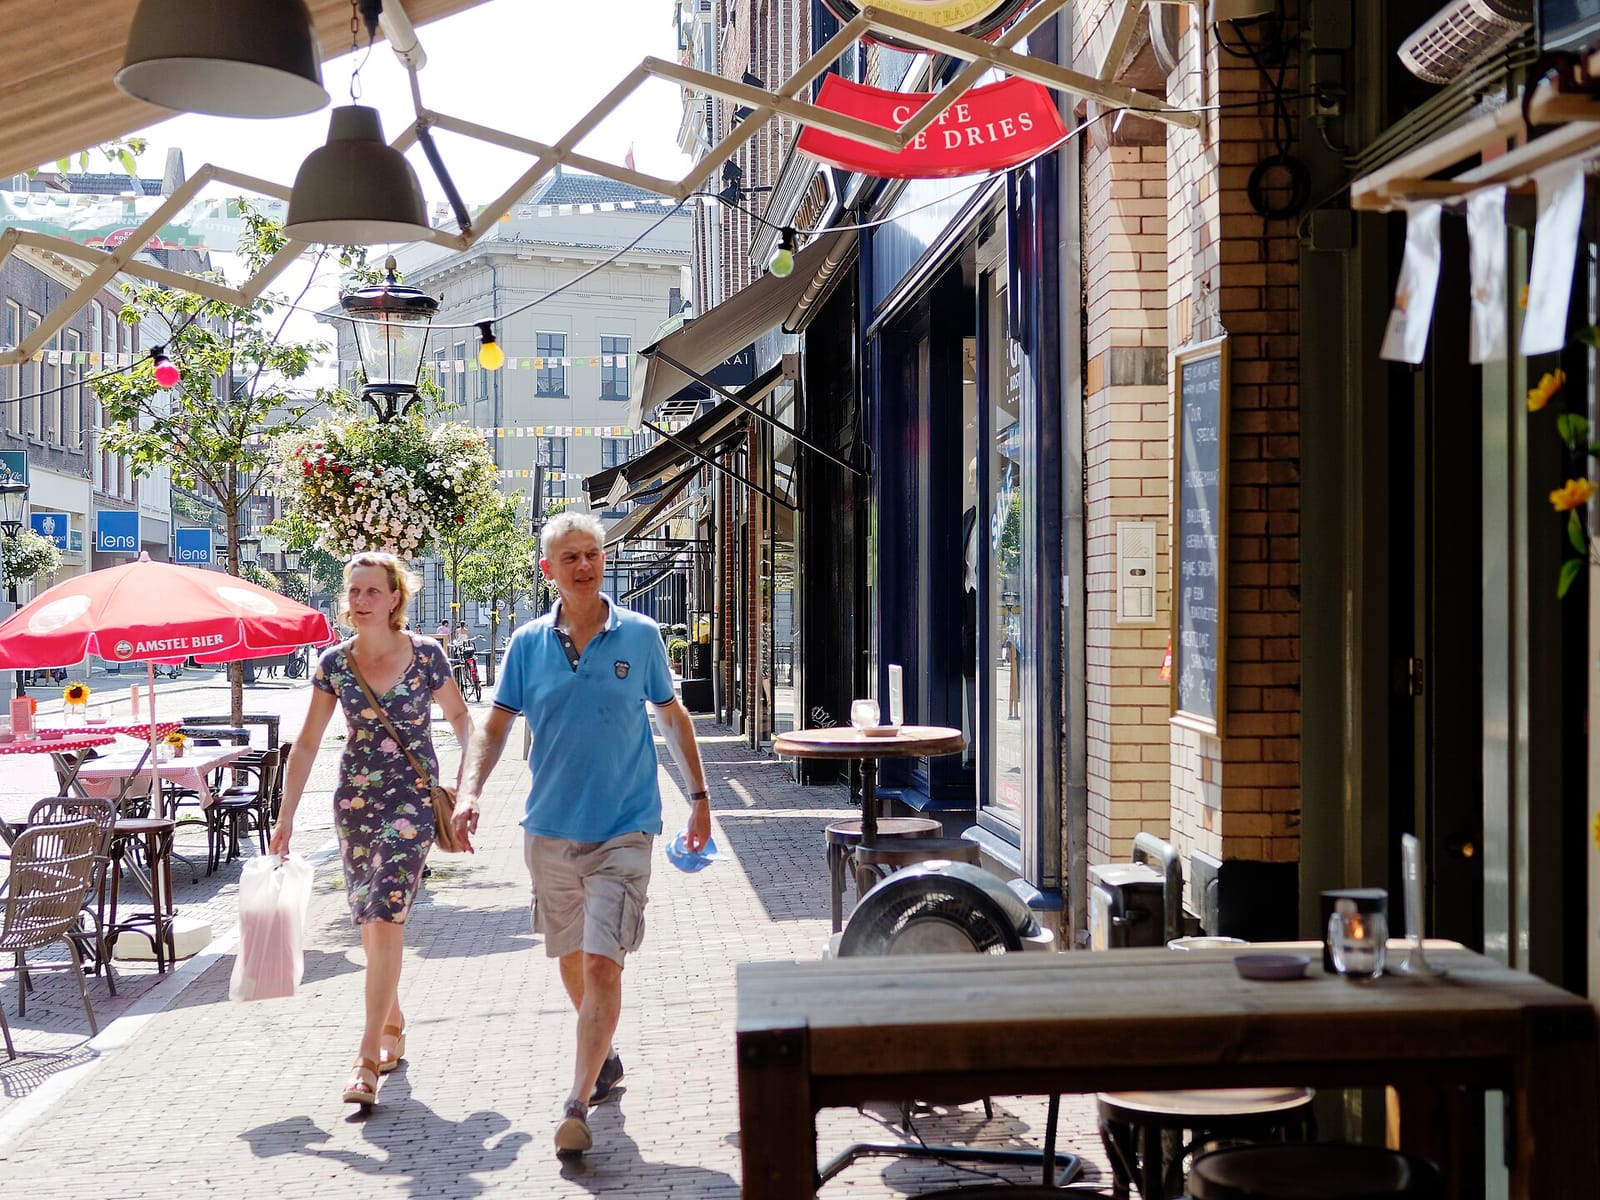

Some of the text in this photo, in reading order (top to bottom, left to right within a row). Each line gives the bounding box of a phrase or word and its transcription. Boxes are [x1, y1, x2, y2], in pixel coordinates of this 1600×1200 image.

[892, 103, 971, 125] CFE
[943, 112, 1033, 149] DRIES
[101, 531, 135, 548] lens
[179, 546, 208, 560] lens
[136, 638, 189, 653] AMSTEL
[192, 634, 224, 648] BIER
